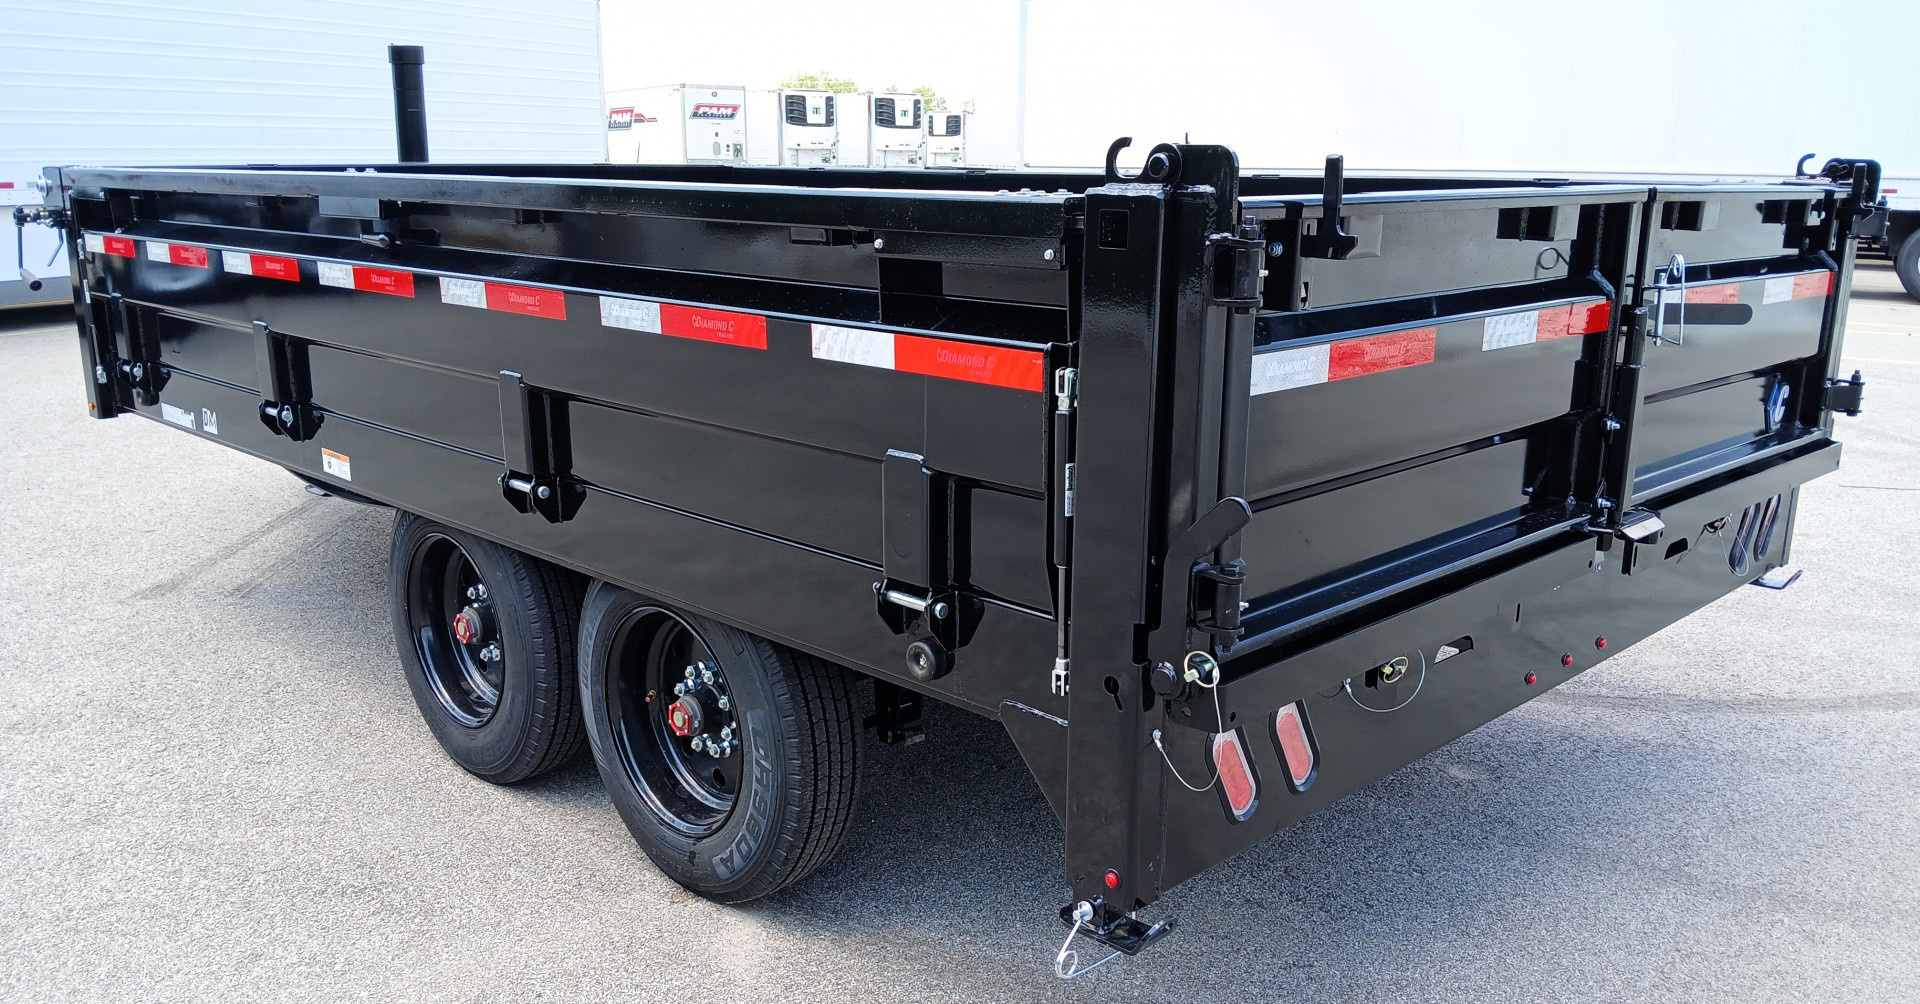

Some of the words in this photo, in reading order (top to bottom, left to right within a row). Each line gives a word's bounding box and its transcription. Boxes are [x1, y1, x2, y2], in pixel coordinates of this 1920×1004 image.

[698, 107, 733, 115] PAM
[511, 292, 535, 305] DIAMOND
[535, 296, 540, 306] C
[696, 316, 727, 331] DIAMOND
[727, 320, 734, 332] C
[941, 349, 985, 368] DIAMOND
[985, 355, 996, 370] C
